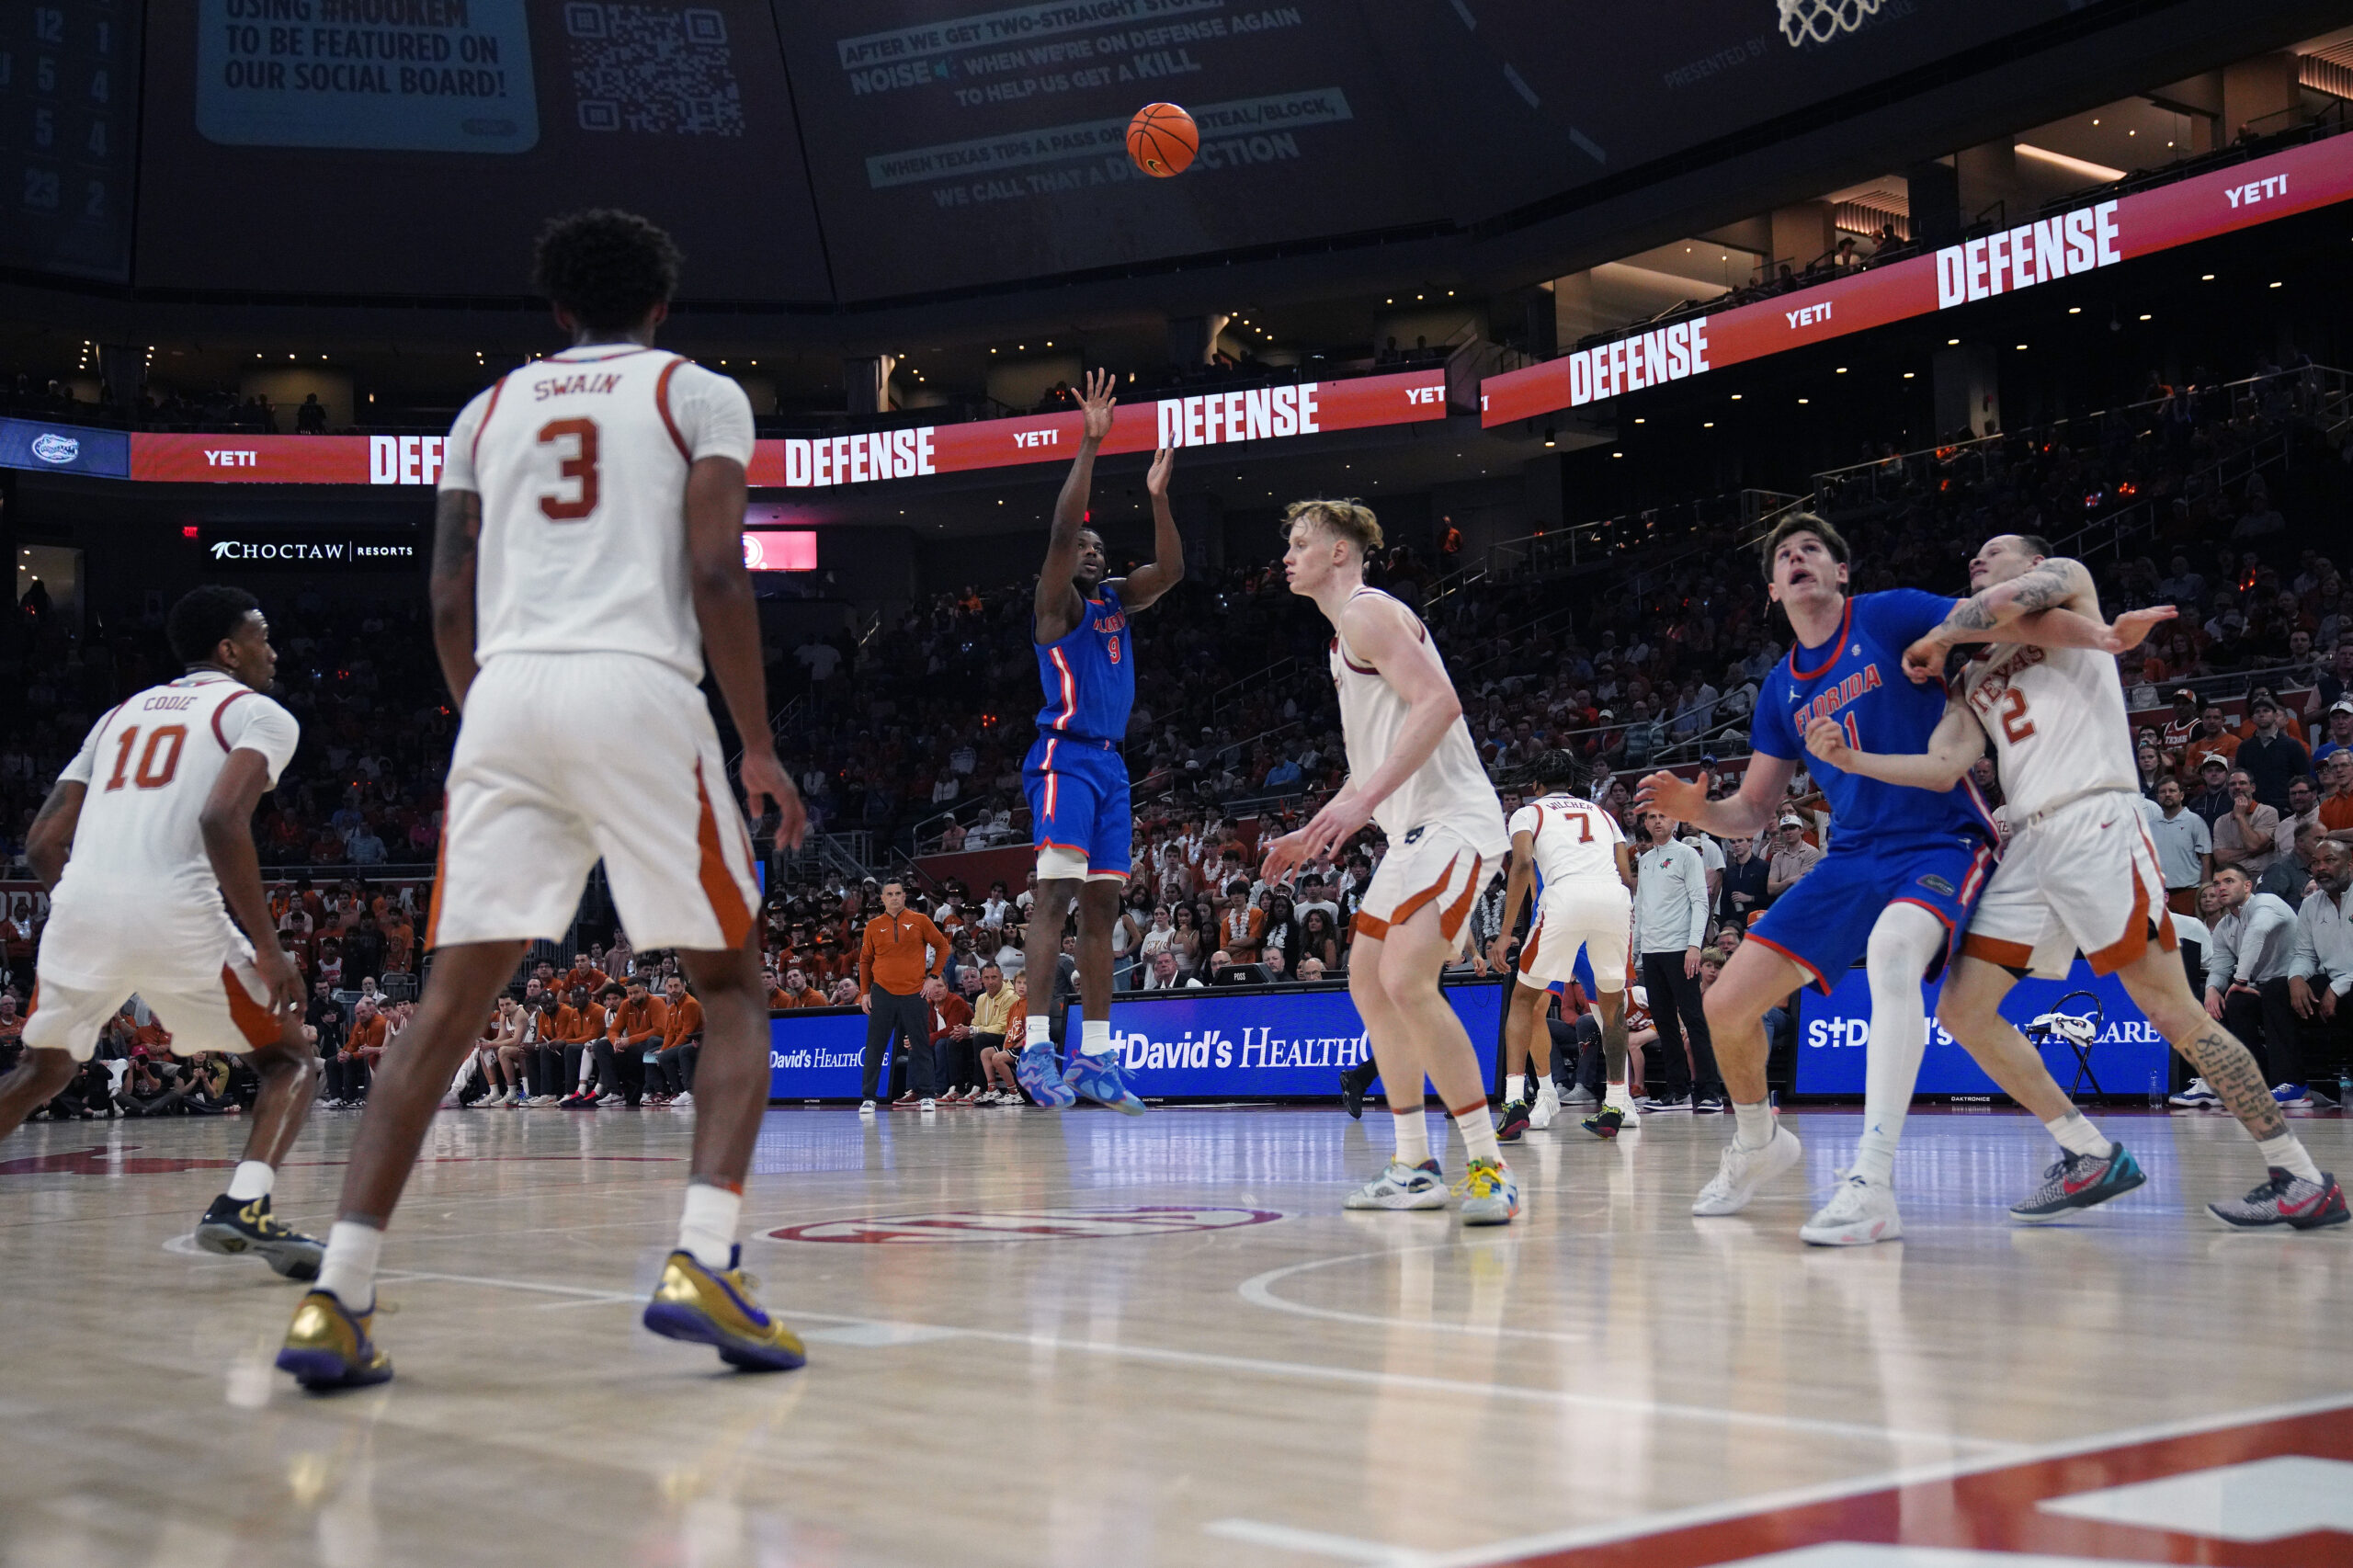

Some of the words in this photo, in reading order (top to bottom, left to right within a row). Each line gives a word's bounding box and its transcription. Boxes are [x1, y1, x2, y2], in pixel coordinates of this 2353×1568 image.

[34, 6, 64, 44] 12
[97, 21, 109, 53] 1
[227, 25, 260, 55] TO
[270, 28, 303, 56] BE
[313, 29, 450, 62] FEATURED
[460, 35, 499, 64] ON
[846, 40, 906, 62] AFTER
[908, 31, 939, 51] WE
[945, 24, 981, 43] GET
[987, 0, 1138, 38] TWO-STRAIGHT
[850, 60, 932, 96] NOISE
[965, 52, 1027, 75] WHEN
[1027, 40, 1094, 66] WE'RE
[1096, 33, 1128, 54] ON
[1130, 17, 1228, 50] DEFENSE
[1232, 7, 1302, 35] AGAIN
[93, 68, 108, 103] 4
[225, 60, 286, 90] OUR
[294, 62, 391, 93] SOCIAL
[400, 67, 506, 97] BOARD!
[954, 88, 984, 108] TO
[986, 78, 1038, 103] HELP
[1040, 74, 1071, 93] US
[1072, 66, 1111, 87] GET
[1119, 63, 1134, 83] A
[1133, 48, 1202, 79] KILL
[881, 156, 932, 178] WHEN
[936, 146, 991, 169] TEXAS
[993, 138, 1032, 160] TIPS
[1035, 138, 1048, 155] A
[1051, 130, 1097, 152] PASS
[1099, 125, 1126, 144] OR
[1197, 97, 1336, 131] STEAL/BLOCK,
[933, 188, 970, 208] WE
[972, 177, 1026, 202] CALL
[1027, 168, 1082, 195] THAT
[1088, 166, 1106, 187] A
[1106, 132, 1301, 183] DCTION
[2224, 173, 2289, 210] YETI
[88, 181, 105, 217] 2
[1936, 199, 2121, 310] DEFENSE
[1786, 301, 1833, 330] YETI
[1569, 316, 1710, 406] DEFENSE
[534, 373, 622, 402] SWAIN
[1157, 382, 1319, 449] DEFENSE
[204, 450, 257, 467] YETI
[785, 426, 936, 486] DEFENSE
[1013, 429, 1059, 449] YETI
[537, 415, 600, 522] 3
[223, 540, 345, 560] CHOCTAW
[358, 546, 413, 556] RESORTS
[1108, 635, 1121, 665] 9
[1793, 663, 1882, 737] FLORIDA
[1970, 644, 2046, 715] TEXAS
[143, 696, 199, 711] CODIE
[2001, 687, 2036, 746] 2
[105, 722, 188, 793] 10
[1546, 800, 1594, 812] WILCHER
[1564, 812, 1595, 844] 7
[1233, 972, 1246, 982] POSS
